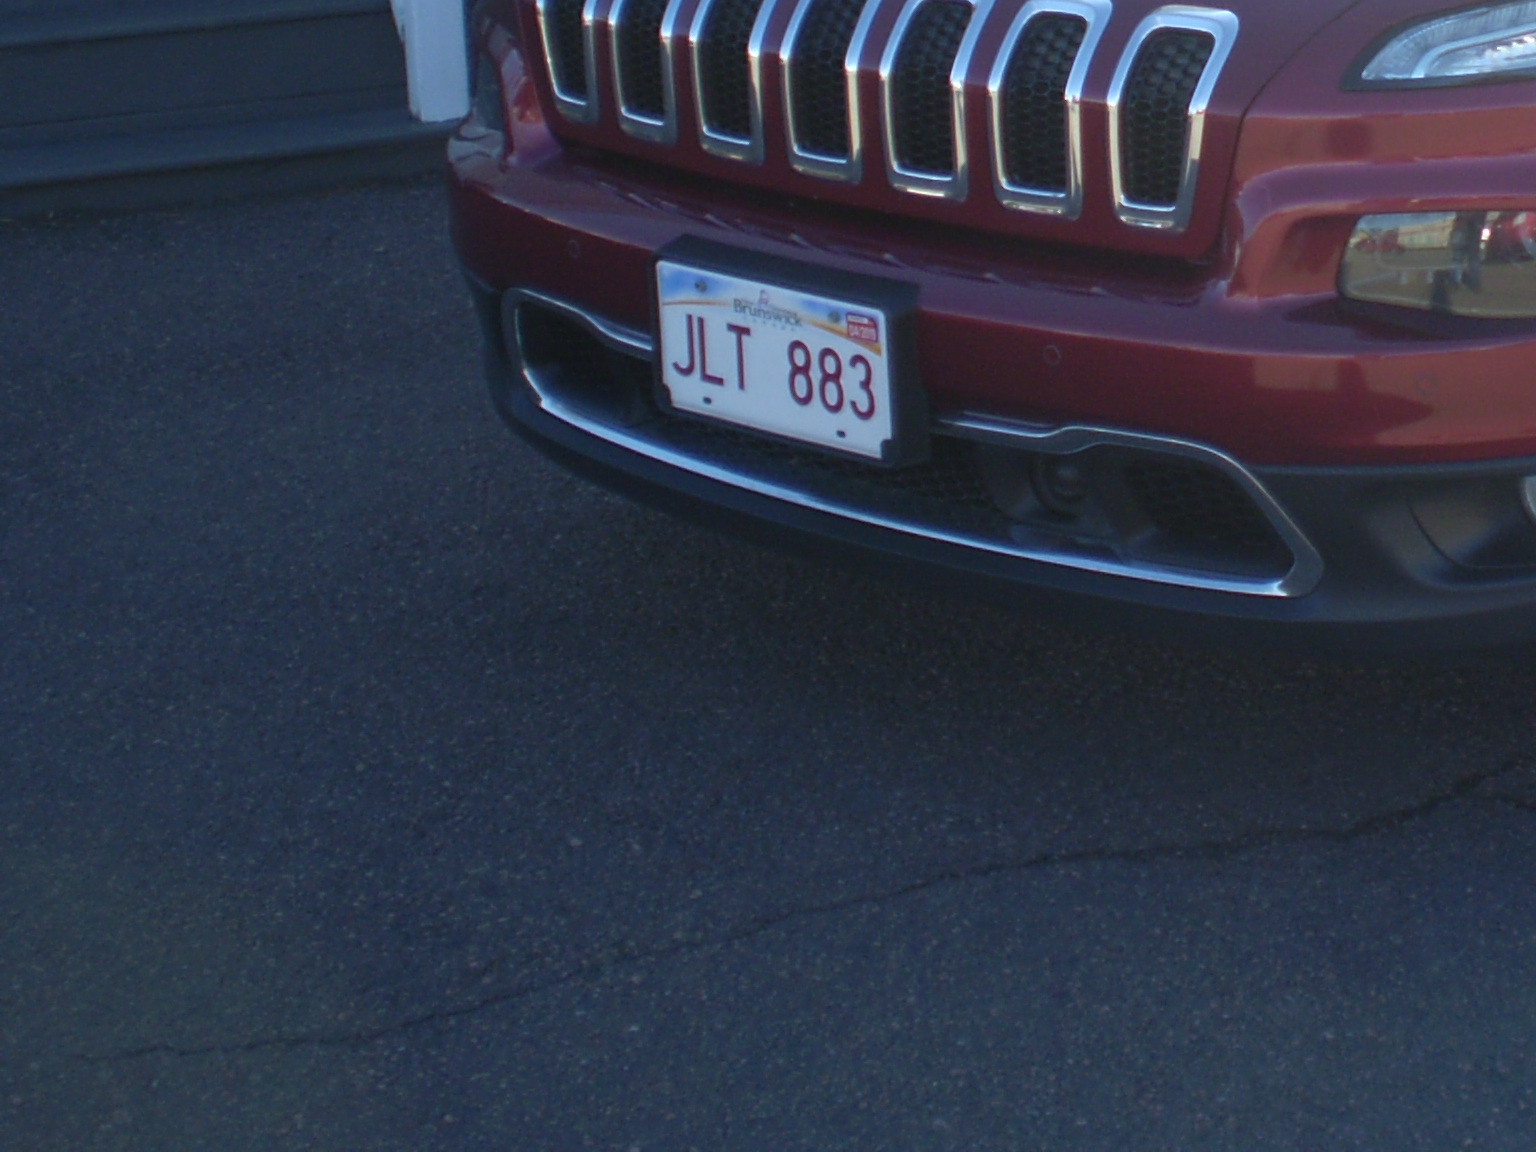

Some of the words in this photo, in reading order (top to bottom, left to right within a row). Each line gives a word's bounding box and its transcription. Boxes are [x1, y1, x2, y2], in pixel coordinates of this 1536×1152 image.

[733, 298, 803, 327] Brunswick
[672, 313, 752, 391] JLT
[787, 339, 876, 421] 883
